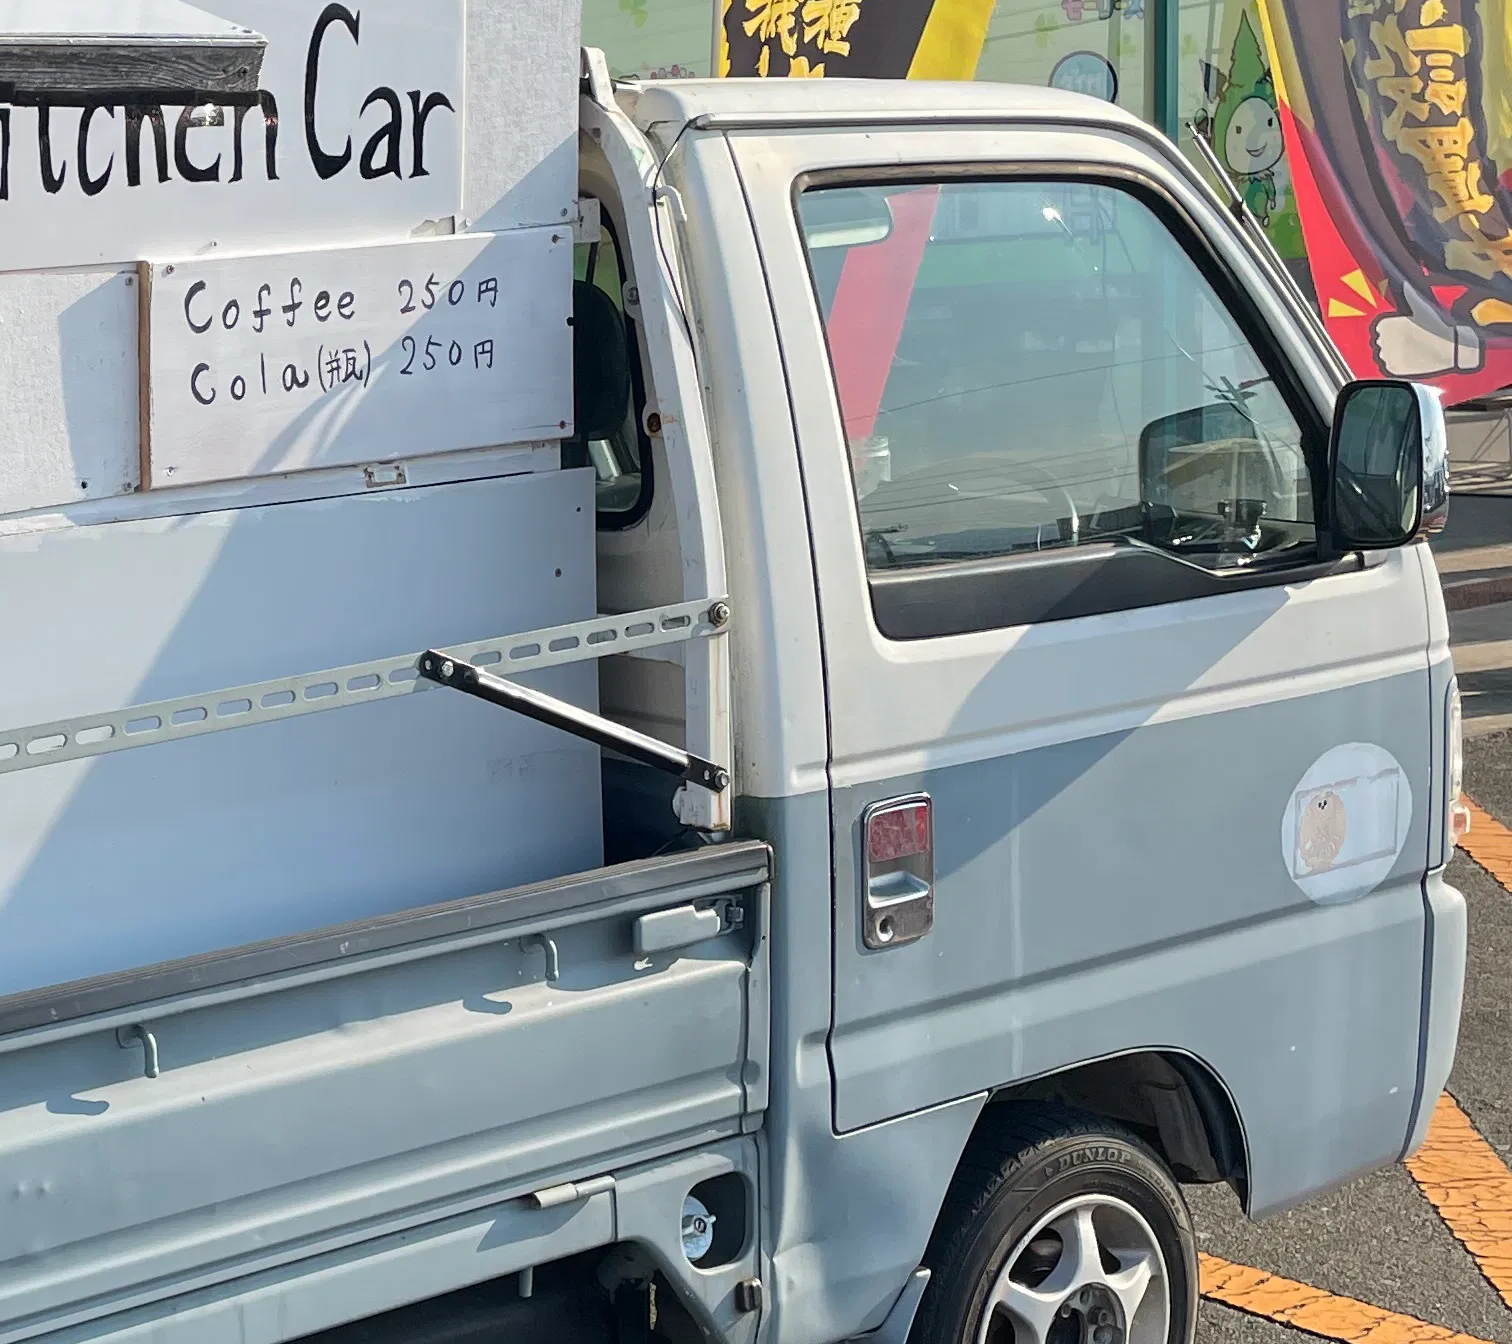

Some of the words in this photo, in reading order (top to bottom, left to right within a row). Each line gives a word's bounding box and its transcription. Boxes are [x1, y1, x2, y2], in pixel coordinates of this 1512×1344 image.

[303, 1, 456, 181] Car
[183, 276, 356, 334] Coffee
[397, 272, 499, 315] 250円
[398, 334, 495, 376] 250円
[1057, 1146, 1132, 1173] DUNLOP
